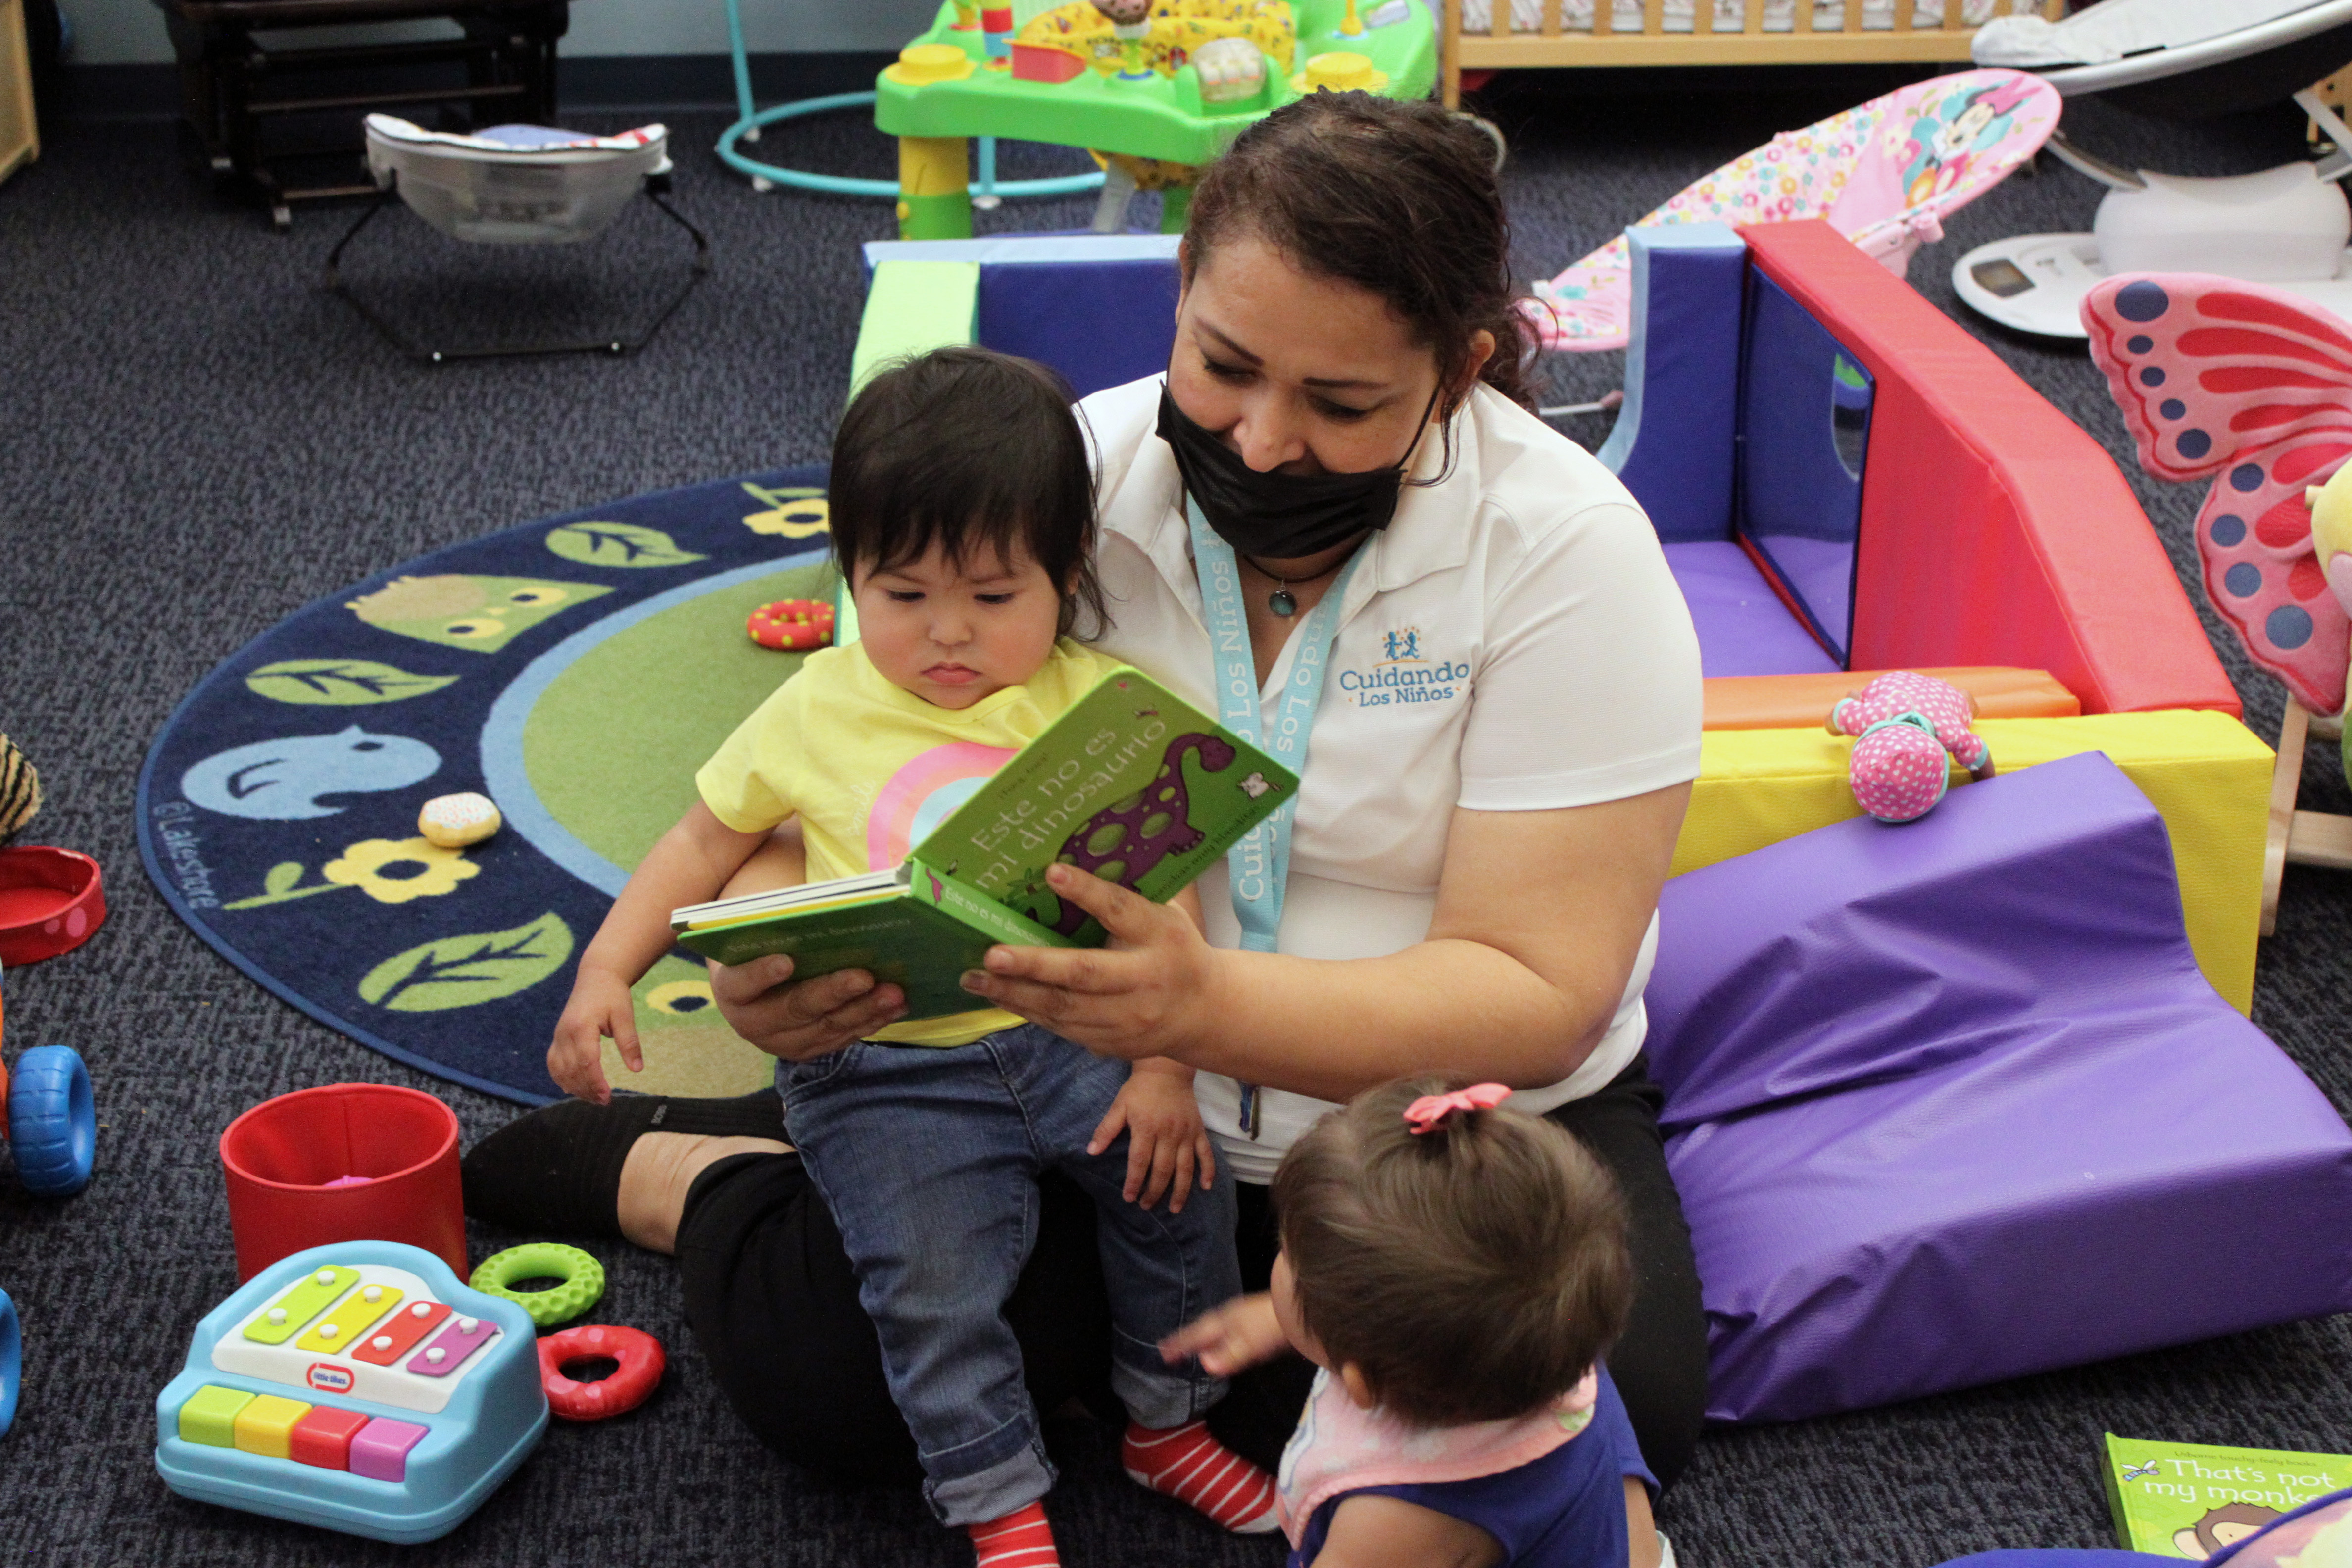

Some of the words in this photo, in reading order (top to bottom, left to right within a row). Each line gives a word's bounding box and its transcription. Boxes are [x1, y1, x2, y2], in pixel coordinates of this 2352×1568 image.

[1211, 560, 1242, 653] Niños
[1226, 662, 1252, 718] Los
[1340, 661, 1470, 691] Cuidando
[1359, 692, 1390, 707] Los
[1395, 687, 1454, 703] Niños
[1277, 695, 1311, 752] Los
[845, 780, 877, 836] smile
[971, 799, 1037, 852] Este
[1038, 759, 1080, 797] no
[1085, 728, 1116, 756] es
[975, 850, 1018, 889] mi
[1019, 720, 1166, 850] dinosaurio
[2165, 1458, 2266, 1483] That's
[2277, 1472, 2336, 1488] not
[2174, 1450, 2217, 1460] Usborne
[2285, 1459, 2317, 1467] books
[2144, 1481, 2197, 1504] my
[2207, 1486, 2321, 1505] monke
